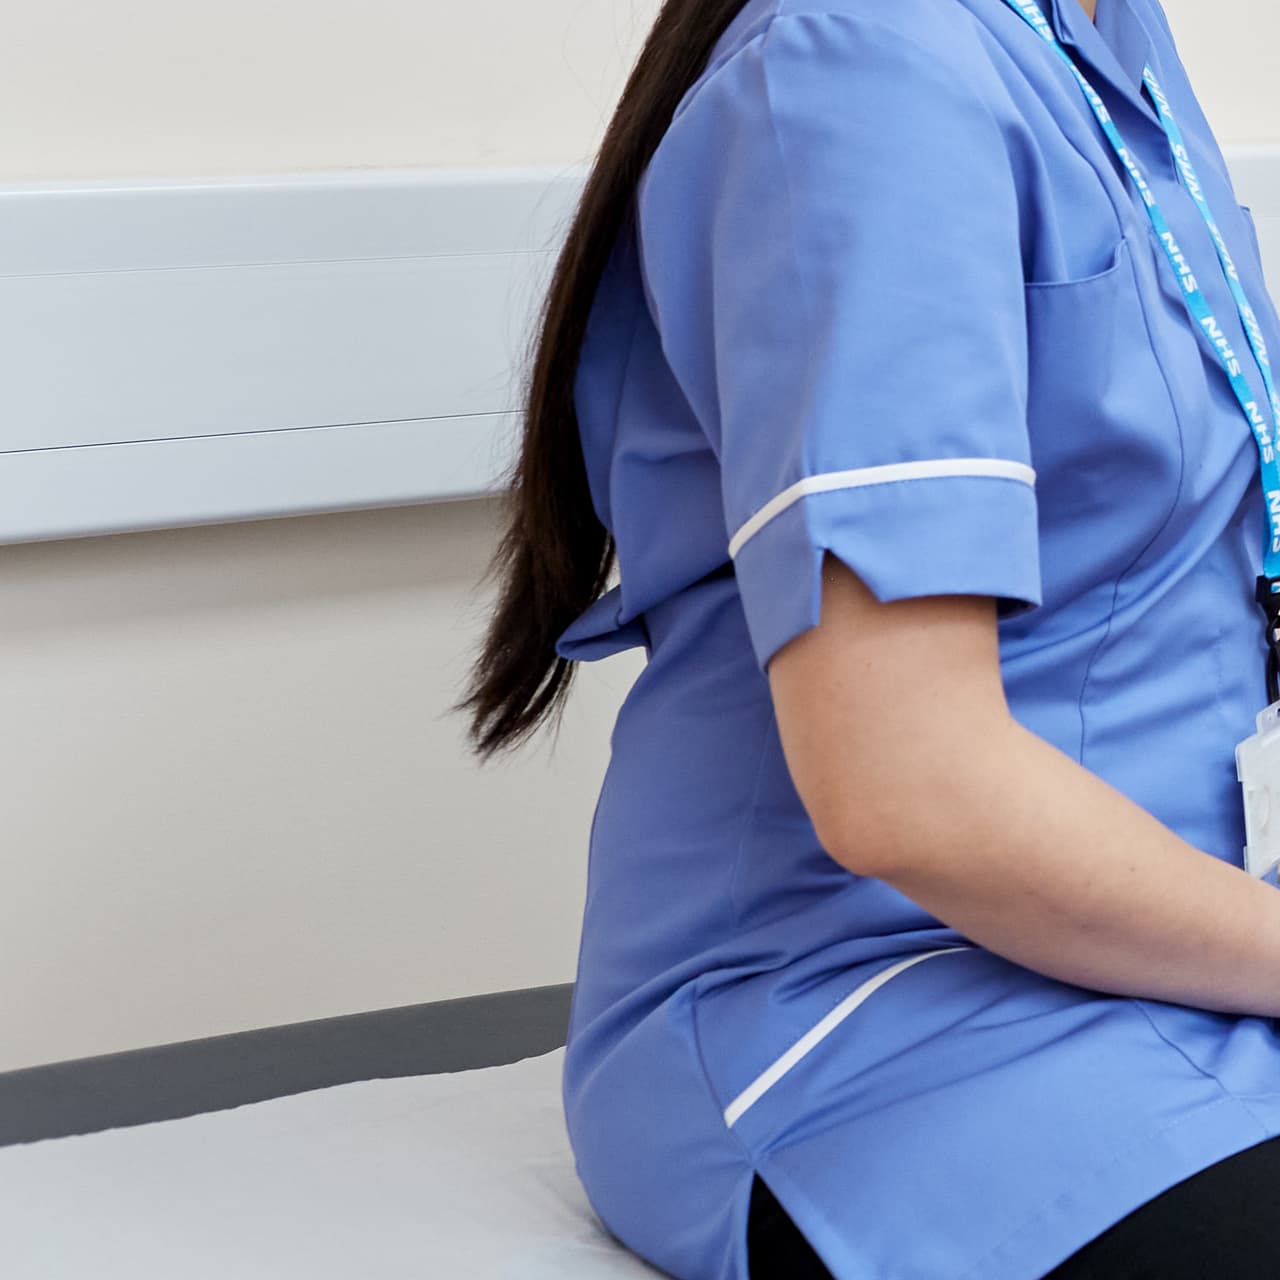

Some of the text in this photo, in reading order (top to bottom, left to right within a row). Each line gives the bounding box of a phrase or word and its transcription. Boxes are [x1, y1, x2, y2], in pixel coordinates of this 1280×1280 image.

[1118, 148, 1156, 208] NHS
[1174, 144, 1204, 202] NHS
[1161, 232, 1199, 294] NHS
[1201, 317, 1241, 378] NHS
[1245, 401, 1275, 465] NHS
